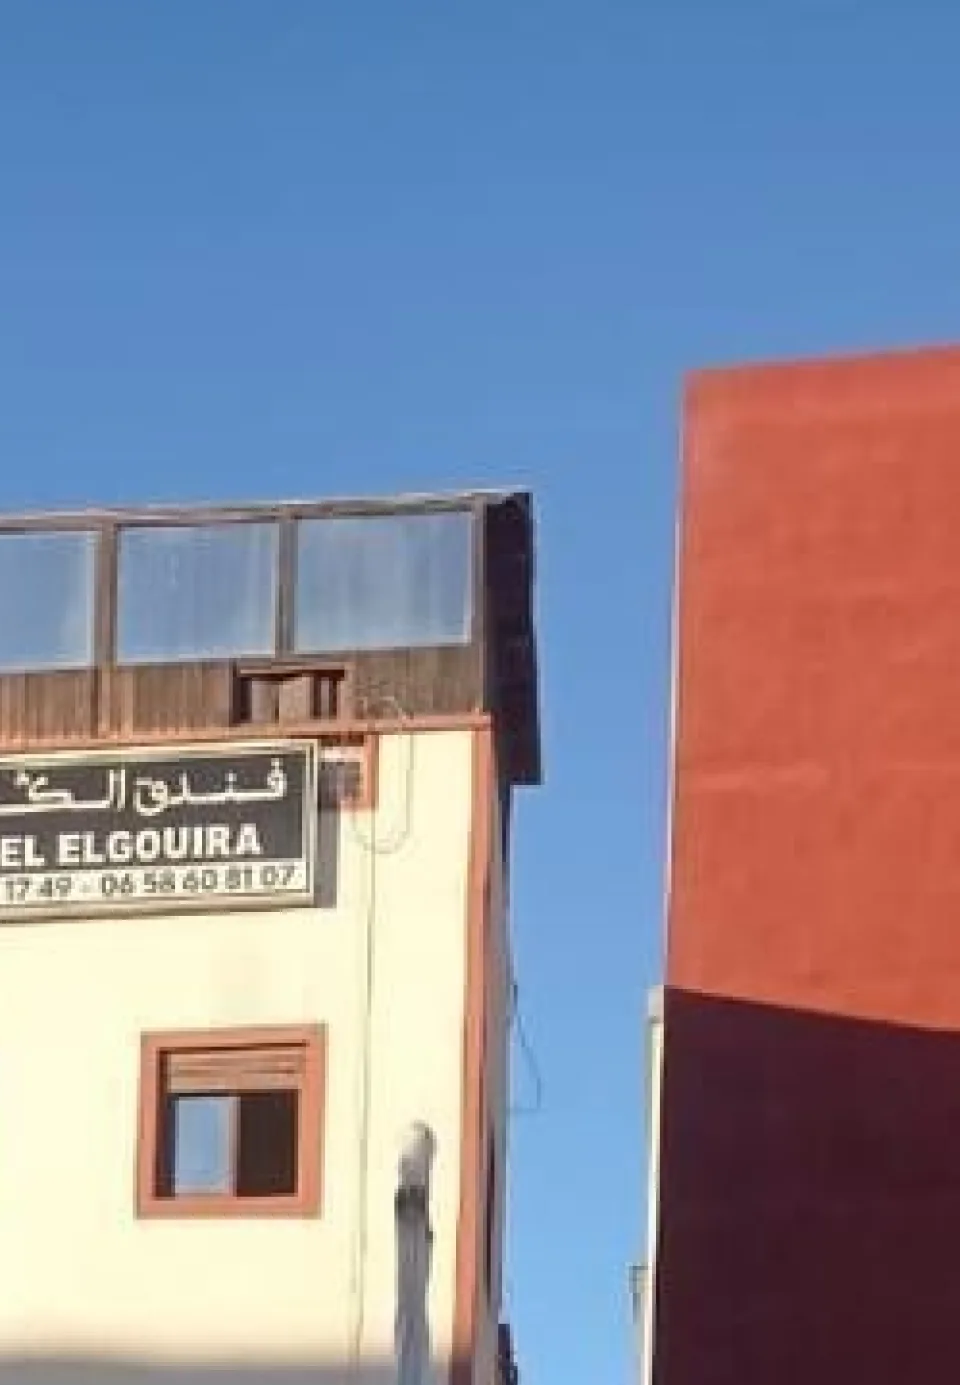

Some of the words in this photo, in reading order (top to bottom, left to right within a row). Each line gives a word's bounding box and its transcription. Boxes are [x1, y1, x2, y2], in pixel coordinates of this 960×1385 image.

[133, 757, 288, 816] فندق
[57, 823, 263, 865] ELGOUIRA
[5, 877, 31, 900] 17
[101, 872, 134, 895] 06
[260, 865, 296, 886] 07
